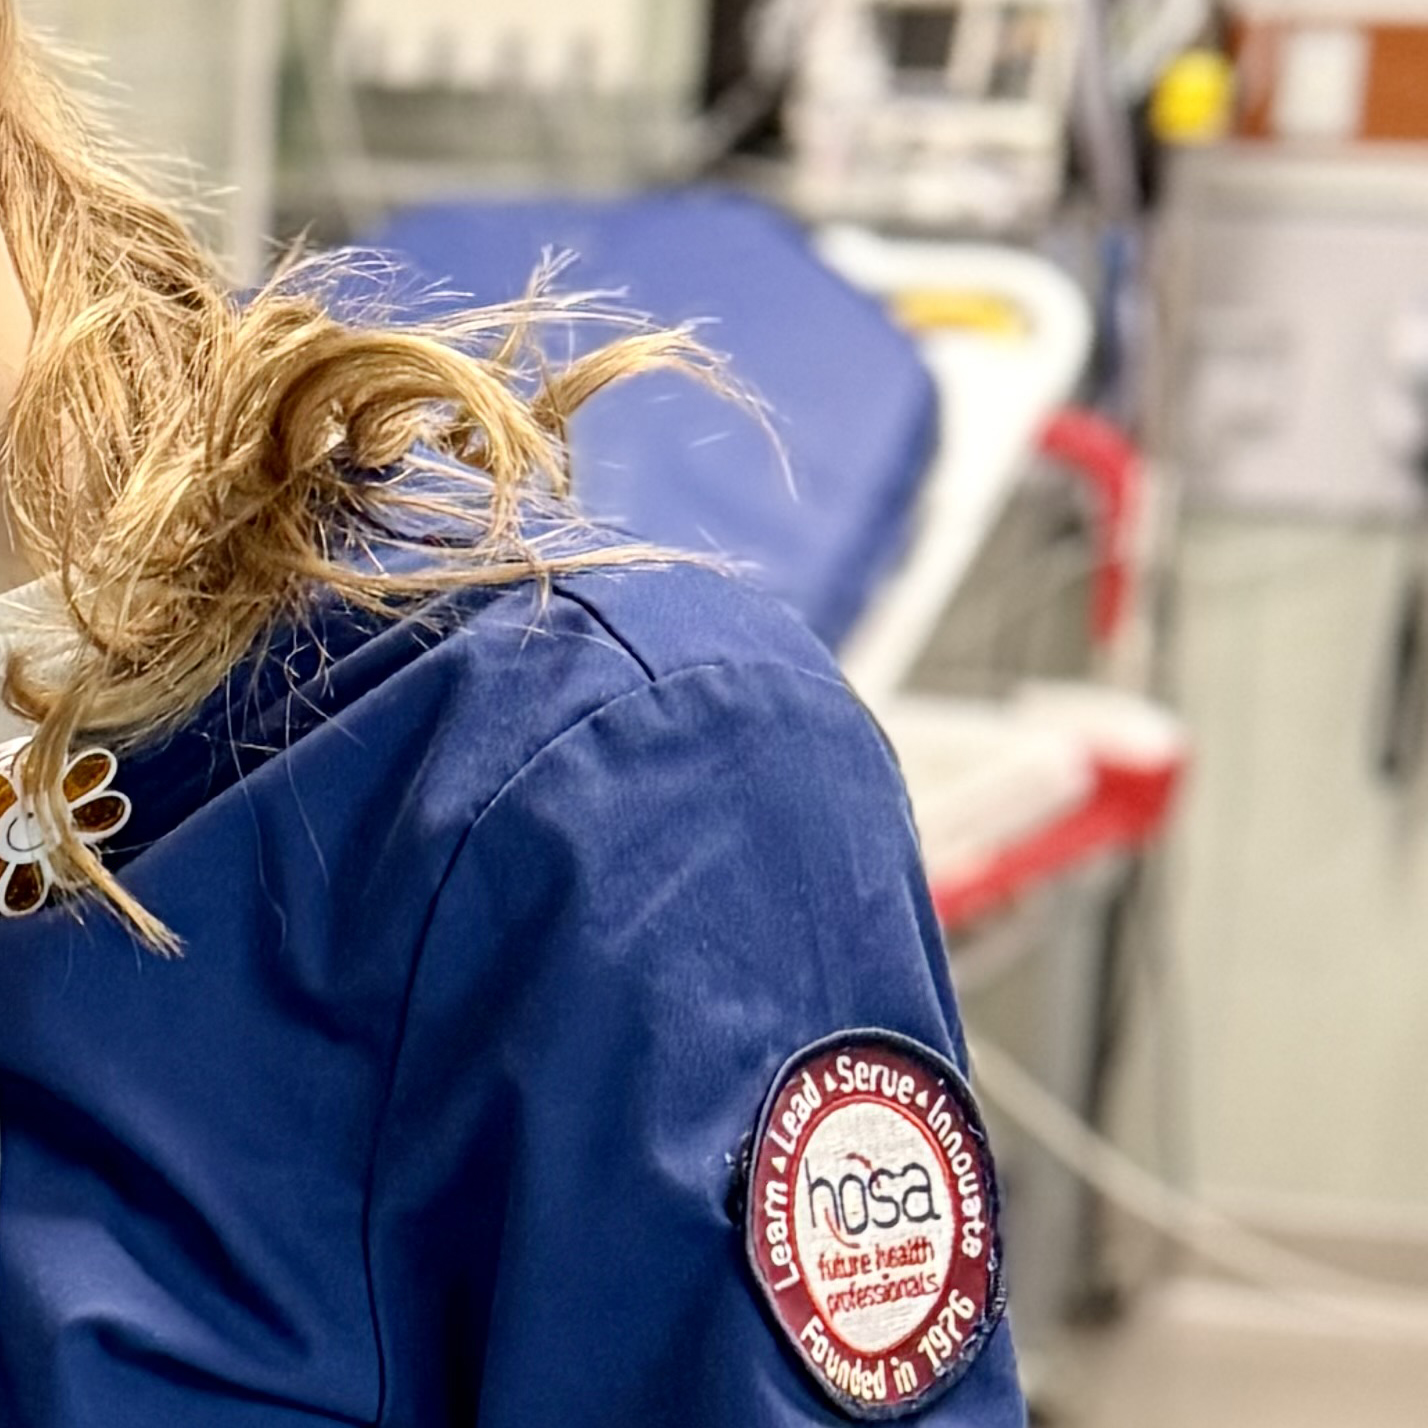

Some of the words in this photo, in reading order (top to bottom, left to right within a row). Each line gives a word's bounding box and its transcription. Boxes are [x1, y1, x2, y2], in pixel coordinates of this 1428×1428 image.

[768, 1068, 823, 1155] Lead
[835, 1054, 916, 1105] Serve
[763, 1180, 801, 1291] Learn
[804, 1156, 942, 1236] hosa
[817, 1251, 872, 1281] future
[874, 1235, 936, 1270] health
[825, 1272, 941, 1320] professionals
[799, 1315, 887, 1401] Founded
[889, 1356, 919, 1395] in
[917, 1288, 977, 1376] 1976
